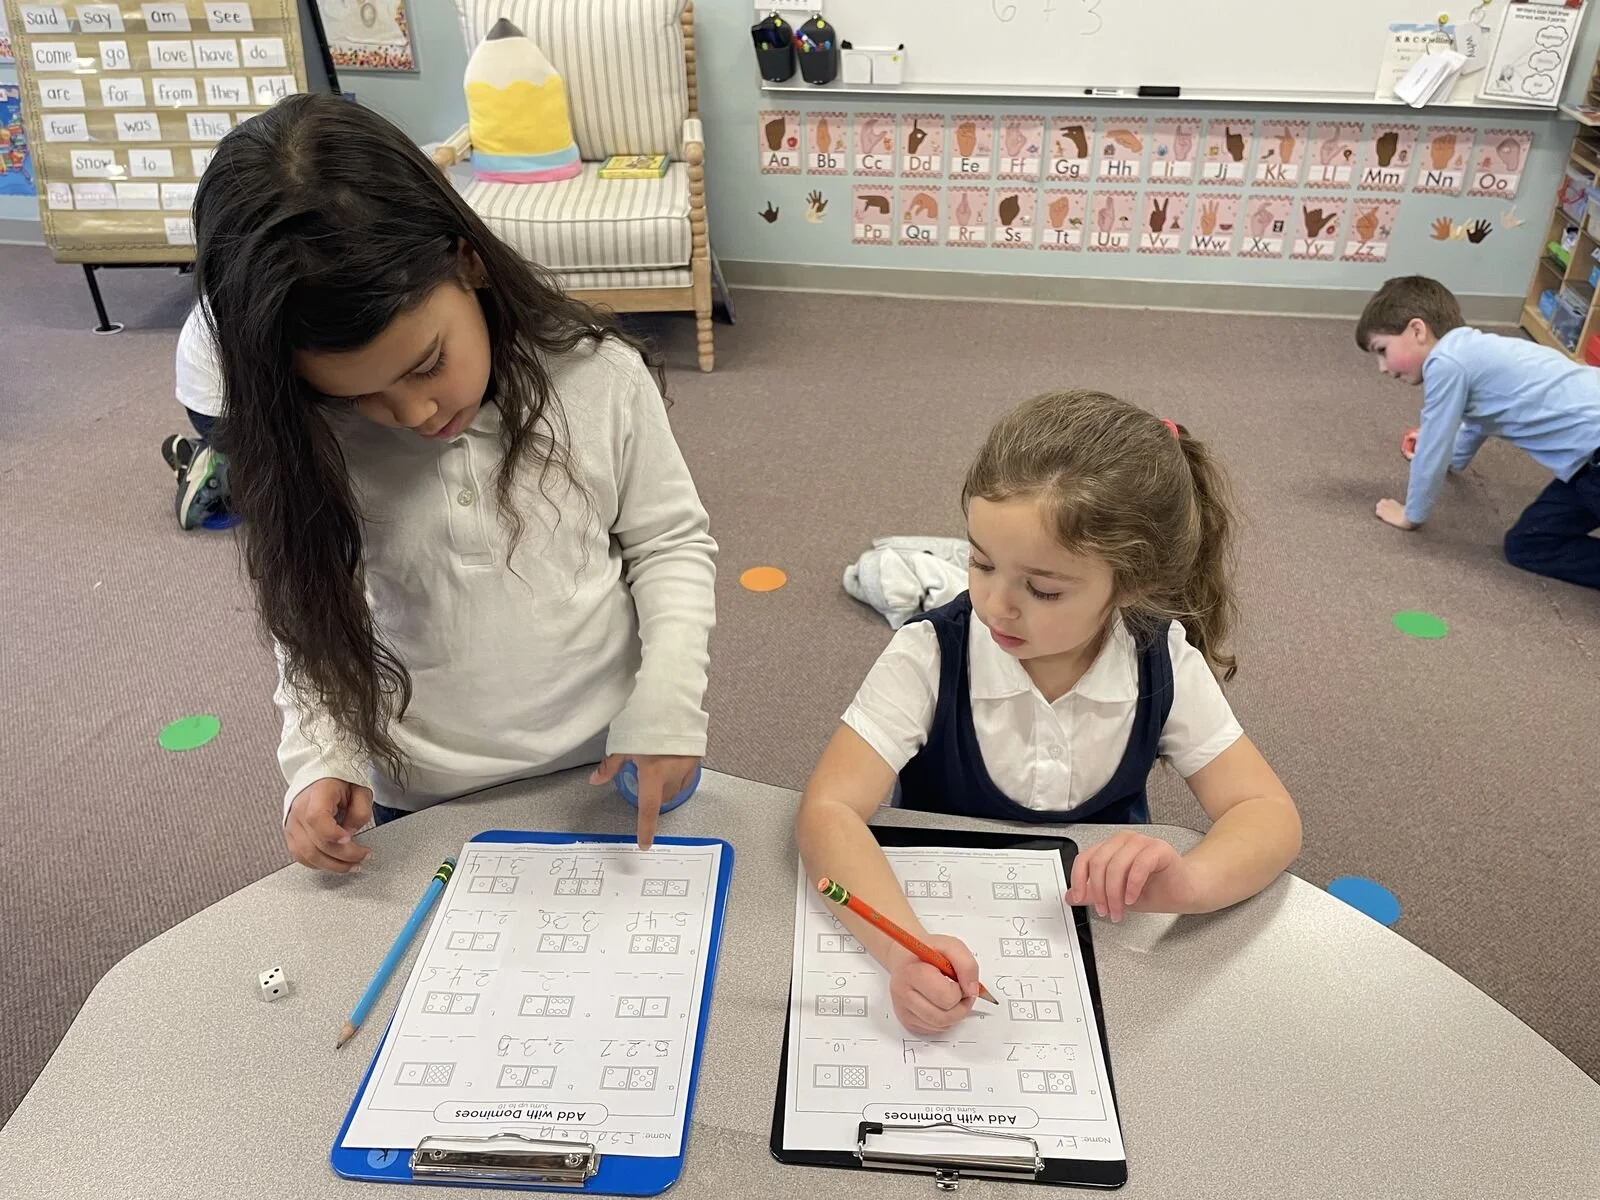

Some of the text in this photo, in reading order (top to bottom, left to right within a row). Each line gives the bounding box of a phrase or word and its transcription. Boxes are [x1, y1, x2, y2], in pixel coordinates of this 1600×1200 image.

[26, 7, 242, 29] said say am see
[36, 44, 267, 67] come go love have do
[47, 87, 70, 100] are
[107, 85, 129, 102] for
[159, 84, 193, 100] from
[211, 84, 240, 105] they
[50, 121, 77, 136] four
[124, 120, 152, 133] was
[192, 117, 227, 136] this
[141, 155, 157, 171] to
[769, 154, 790, 167] Aa
[817, 154, 837, 169] Bb
[862, 154, 883, 170] Cc
[909, 155, 932, 171] Dd
[961, 158, 980, 173] Ee
[1010, 159, 1027, 173] Ff
[1108, 160, 1132, 176] Hh
[1055, 160, 1080, 178] Gg
[1165, 162, 1174, 177] Ii
[1215, 163, 1228, 181] Jj
[1264, 164, 1288, 180] Kk
[1322, 166, 1337, 182] Ll
[1364, 169, 1400, 185] Mm
[1425, 172, 1452, 188] Nn
[1479, 174, 1508, 190] Oo
[864, 225, 882, 240] Pp
[906, 225, 930, 241] Qq
[959, 226, 975, 240] Rr
[1004, 227, 1022, 242] Ss
[1055, 230, 1069, 244] Tt
[1097, 231, 1121, 247] Uu
[1148, 233, 1169, 247] Vv
[1195, 235, 1226, 250] Ww
[1250, 237, 1270, 253] Xx
[1304, 240, 1324, 257] Yy
[1354, 242, 1374, 256] Zz
[518, 1102, 529, 1110] up
[945, 1105, 956, 1113] up
[957, 1106, 976, 1114] Sums
[455, 1109, 586, 1122] Add with Dominoes
[884, 1112, 1017, 1125] Add with Dominoes
